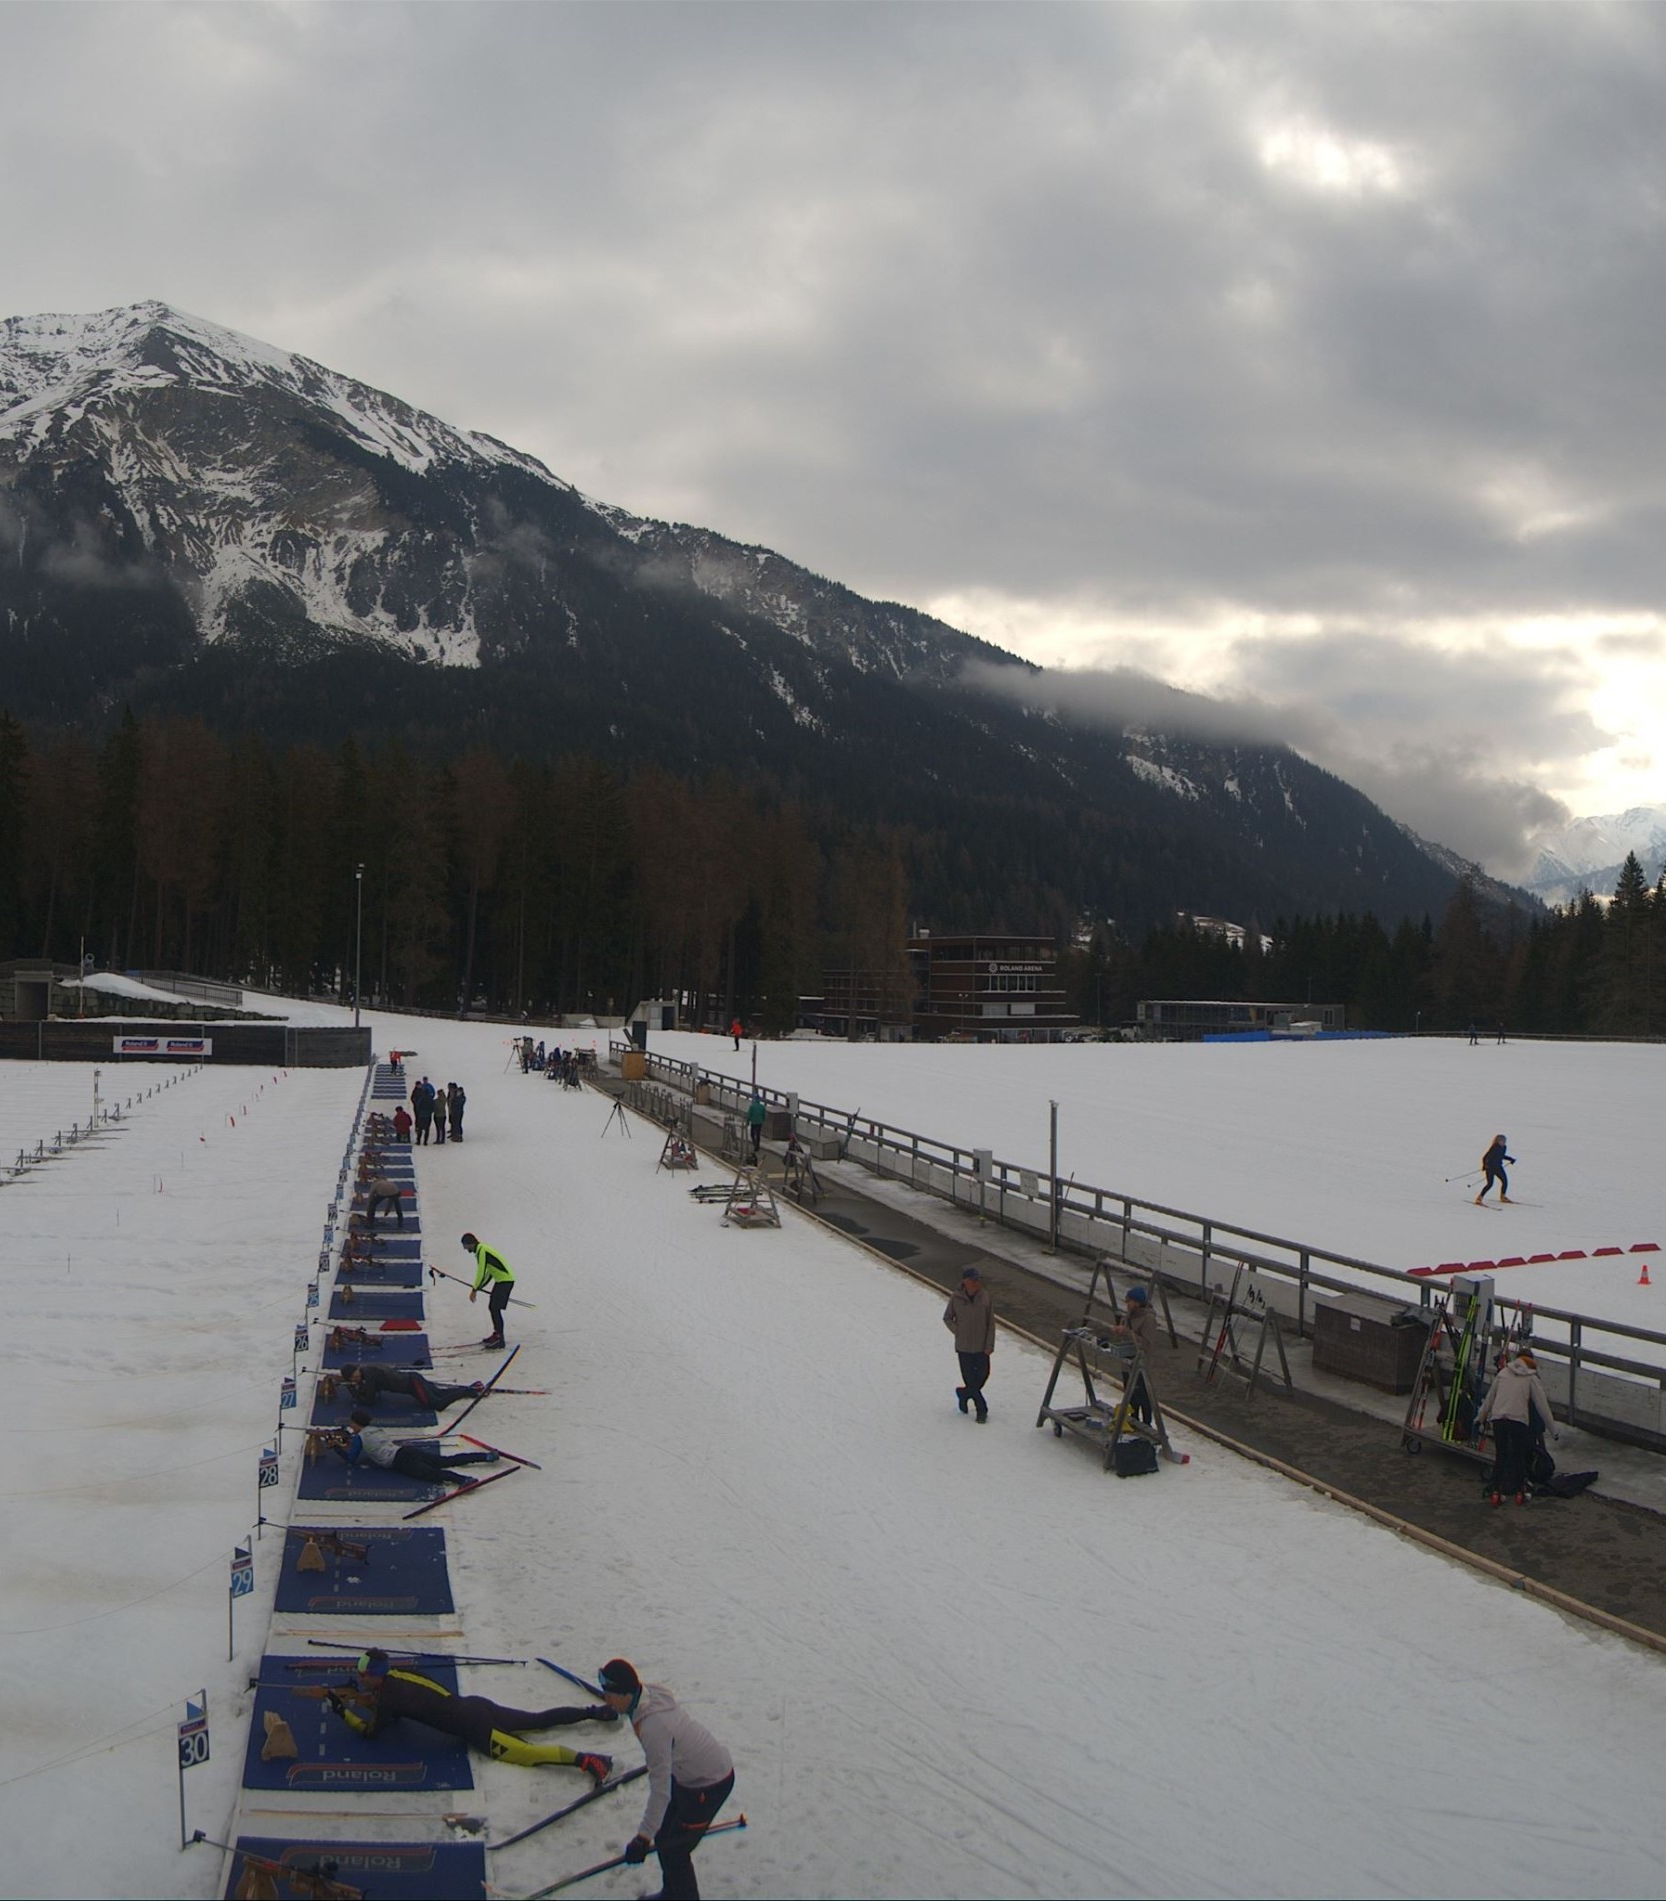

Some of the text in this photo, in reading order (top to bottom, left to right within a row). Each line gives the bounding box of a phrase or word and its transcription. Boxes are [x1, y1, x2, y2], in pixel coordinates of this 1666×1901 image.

[295, 1336, 308, 1351] 26
[281, 1392, 294, 1408] 27
[260, 1465, 278, 1487] 28
[233, 1570, 252, 1596] 29
[180, 1731, 208, 1767] 30
[322, 1770, 396, 1781] Roland
[319, 1854, 402, 1869] Roland
